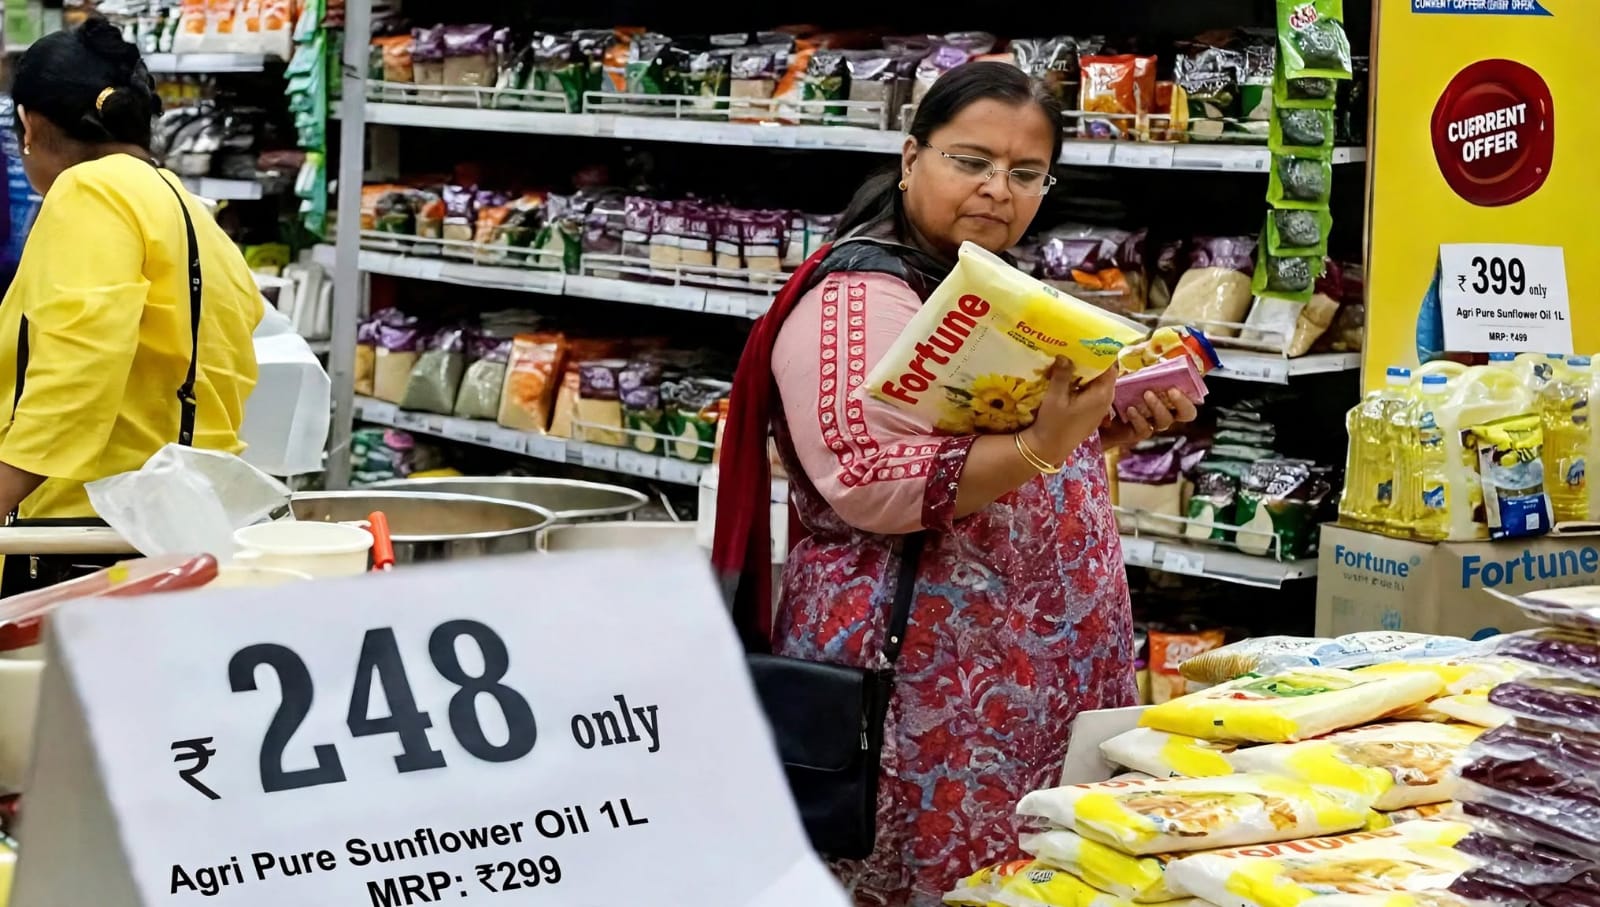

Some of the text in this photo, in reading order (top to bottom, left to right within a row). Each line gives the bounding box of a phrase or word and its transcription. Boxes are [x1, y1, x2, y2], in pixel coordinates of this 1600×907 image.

[1462, 130, 1518, 163] OFFER
[1456, 256, 1547, 299] ₹ 399 only
[1456, 307, 1565, 321] Agri Pure Sunflower Oil 1L
[881, 294, 991, 405] Fortune
[1488, 332, 1528, 342] MRP: ₹499
[1335, 544, 1409, 577] Fortune
[1462, 546, 1599, 589] Fortune
[170, 619, 660, 801] ₹ 248 only
[169, 797, 650, 898] Agri Pure Sunflower Oil 1L
[366, 854, 563, 907] MRP: ₹299
